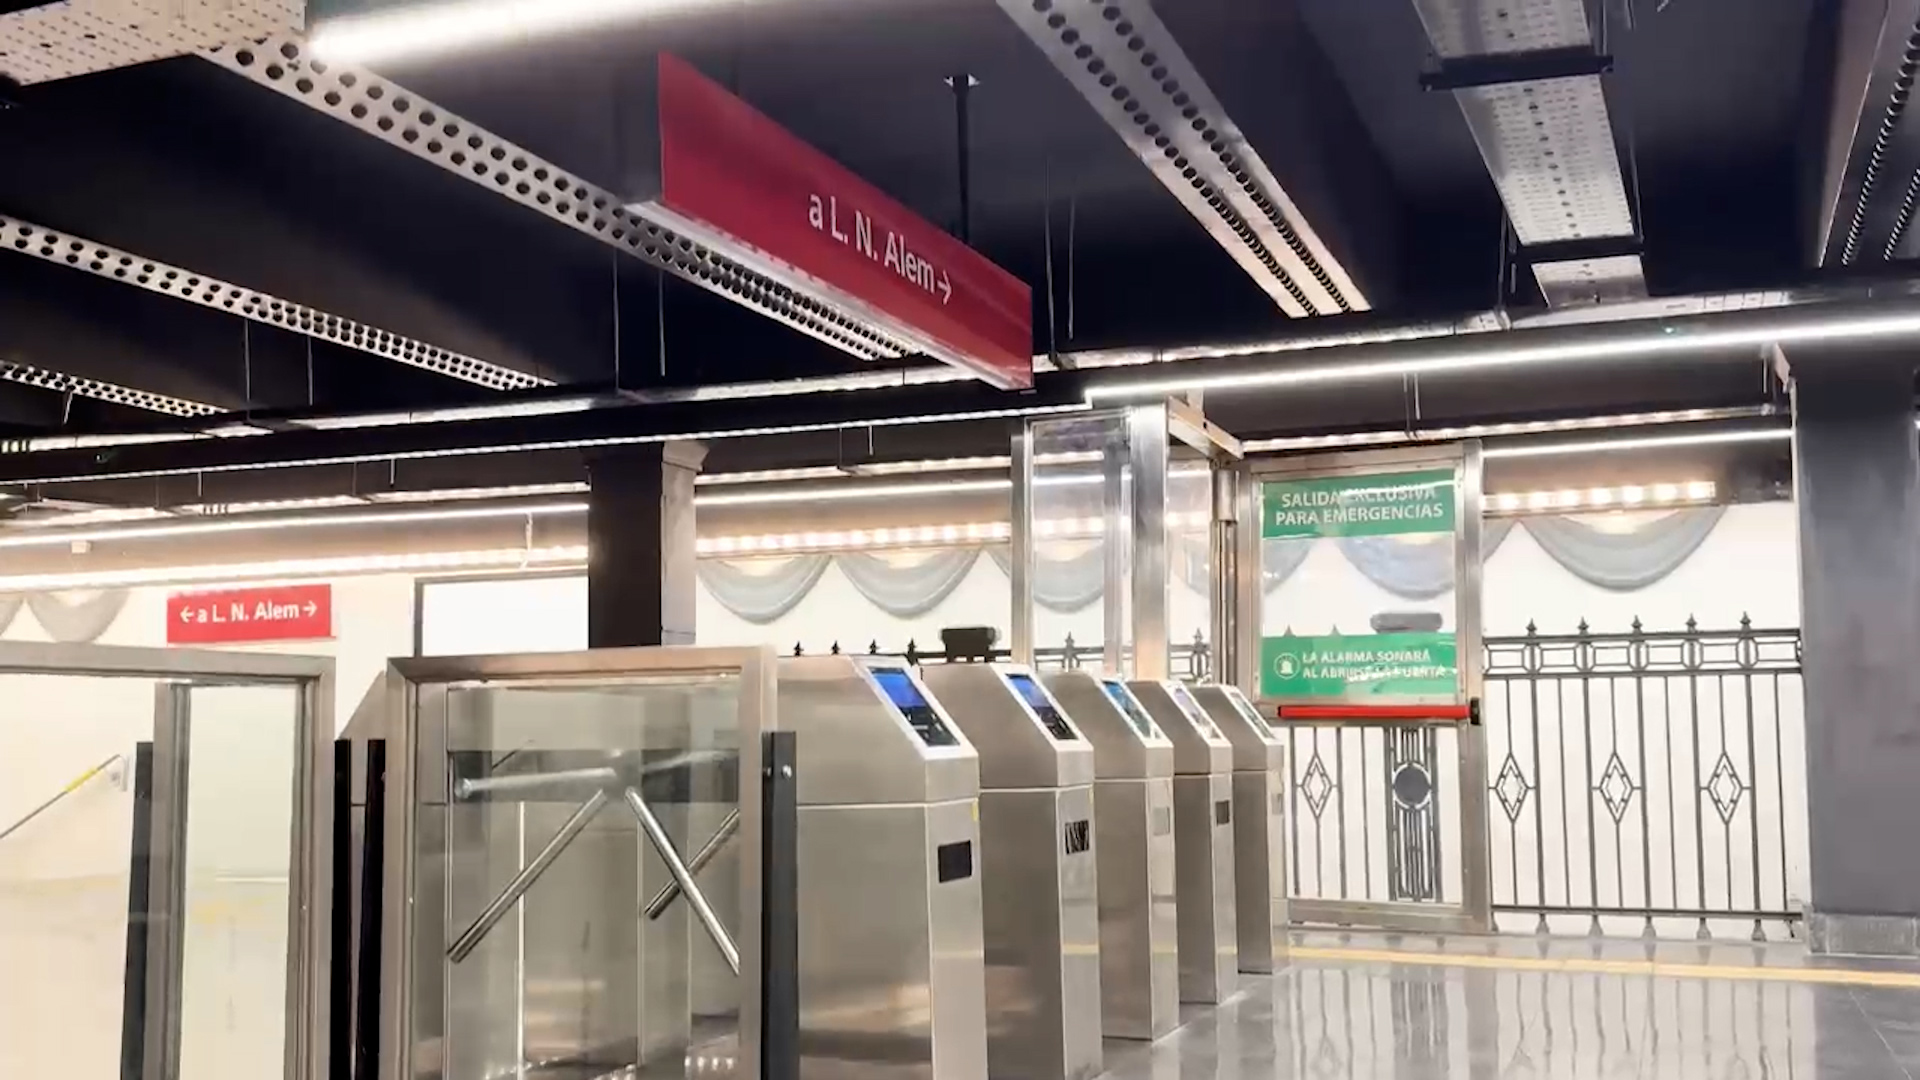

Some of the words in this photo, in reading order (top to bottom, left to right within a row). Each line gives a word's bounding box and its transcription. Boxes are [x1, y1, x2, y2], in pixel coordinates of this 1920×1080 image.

[809, 194, 823, 230] a
[830, 195, 849, 246] L.
[855, 209, 879, 262] N.
[883, 231, 935, 294] Alem
[1281, 490, 1341, 508] SALIDA
[1342, 487, 1437, 503] XCLUSIVA
[1275, 510, 1319, 526] PARA
[1323, 502, 1444, 524] EMERGENCIAS
[197, 608, 208, 623] a
[212, 604, 227, 623] L.
[230, 601, 250, 622] N.
[253, 599, 300, 621] Alem
[1302, 651, 1319, 664] LA
[1320, 650, 1375, 664] ALARMA
[1302, 666, 1318, 679] AL
[1393, 664, 1447, 678] UERTA
